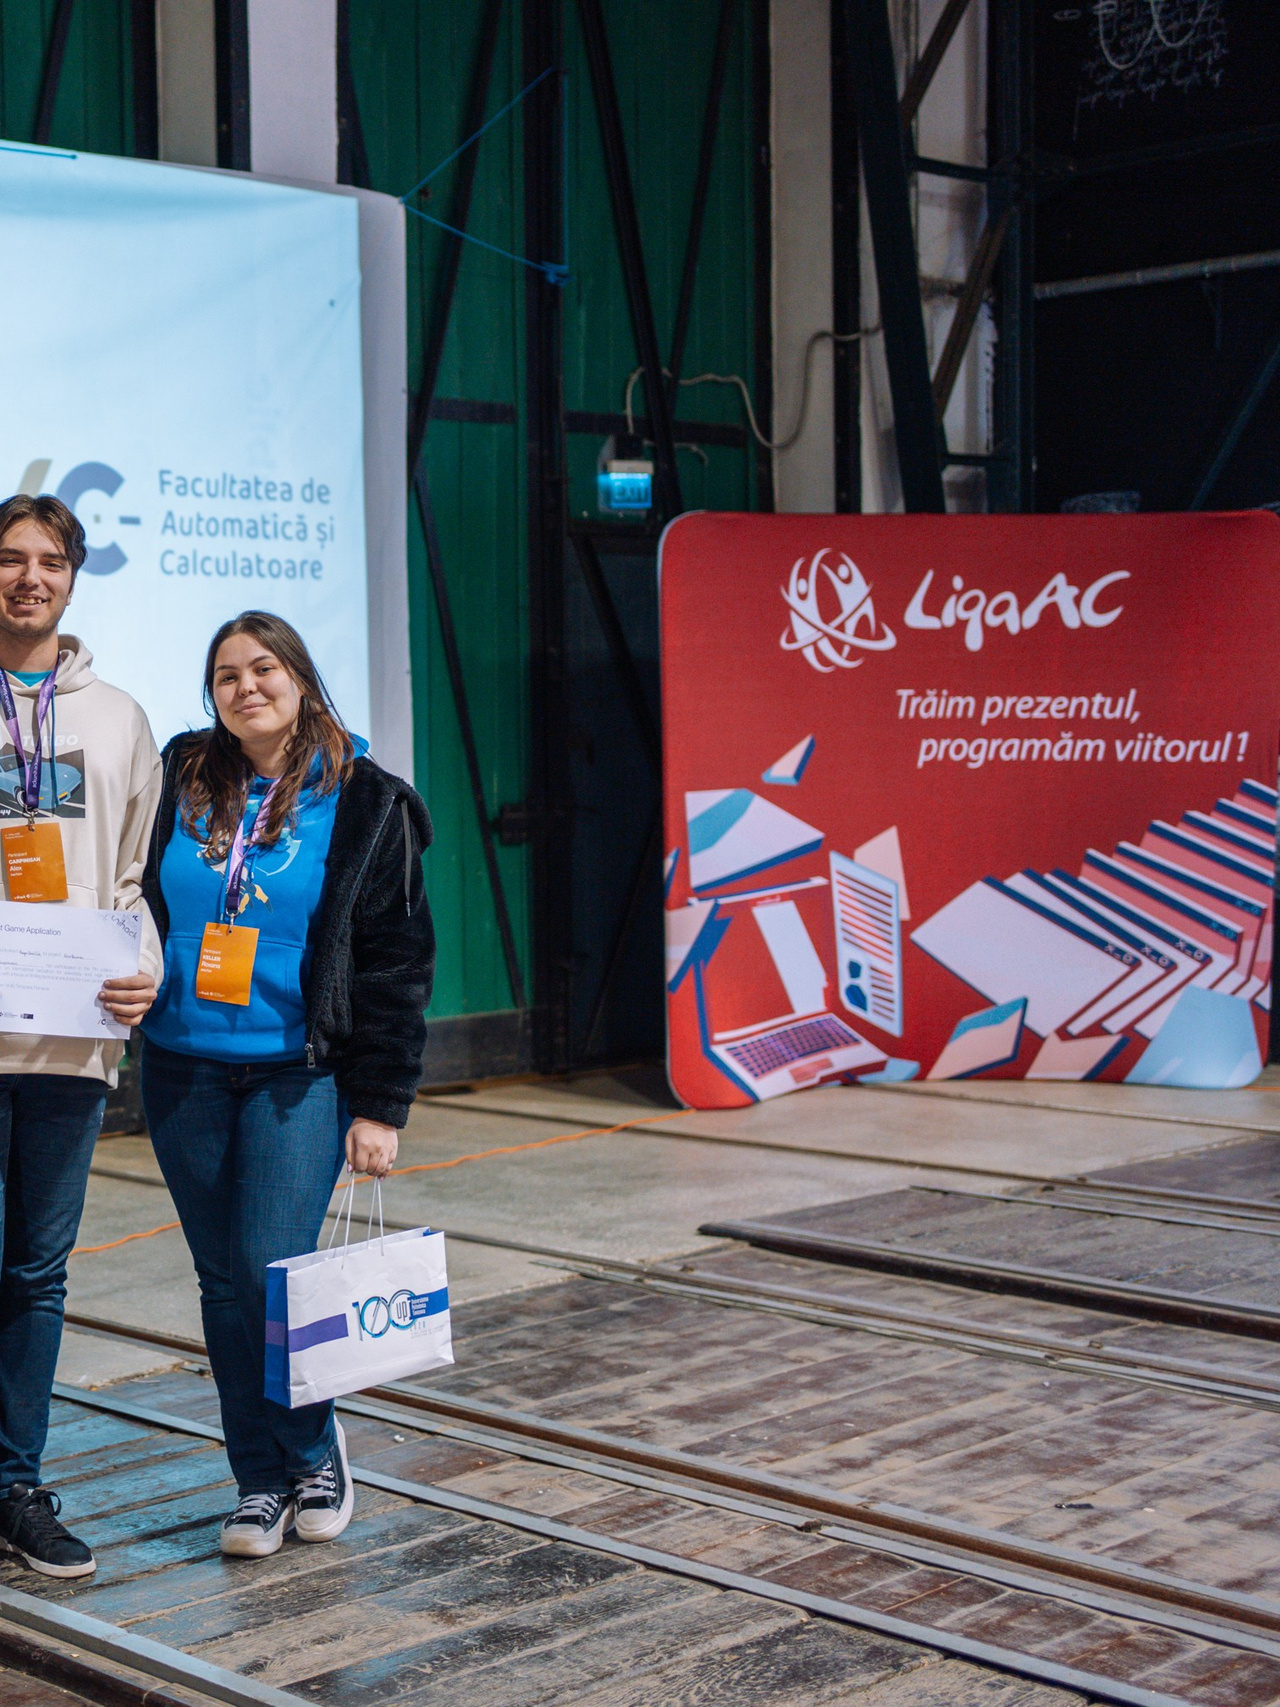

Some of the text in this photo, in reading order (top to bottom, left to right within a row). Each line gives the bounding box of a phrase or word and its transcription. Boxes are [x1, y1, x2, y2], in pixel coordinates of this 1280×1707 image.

[158, 469, 331, 504] Facultatea de
[160, 511, 309, 541] Automatică
[159, 550, 324, 580] Calculatoare
[896, 688, 1142, 726] Trăim prezentul,
[916, 732, 1107, 769] programăm
[4, 924, 25, 933] Game
[26, 926, 61, 936] Application
